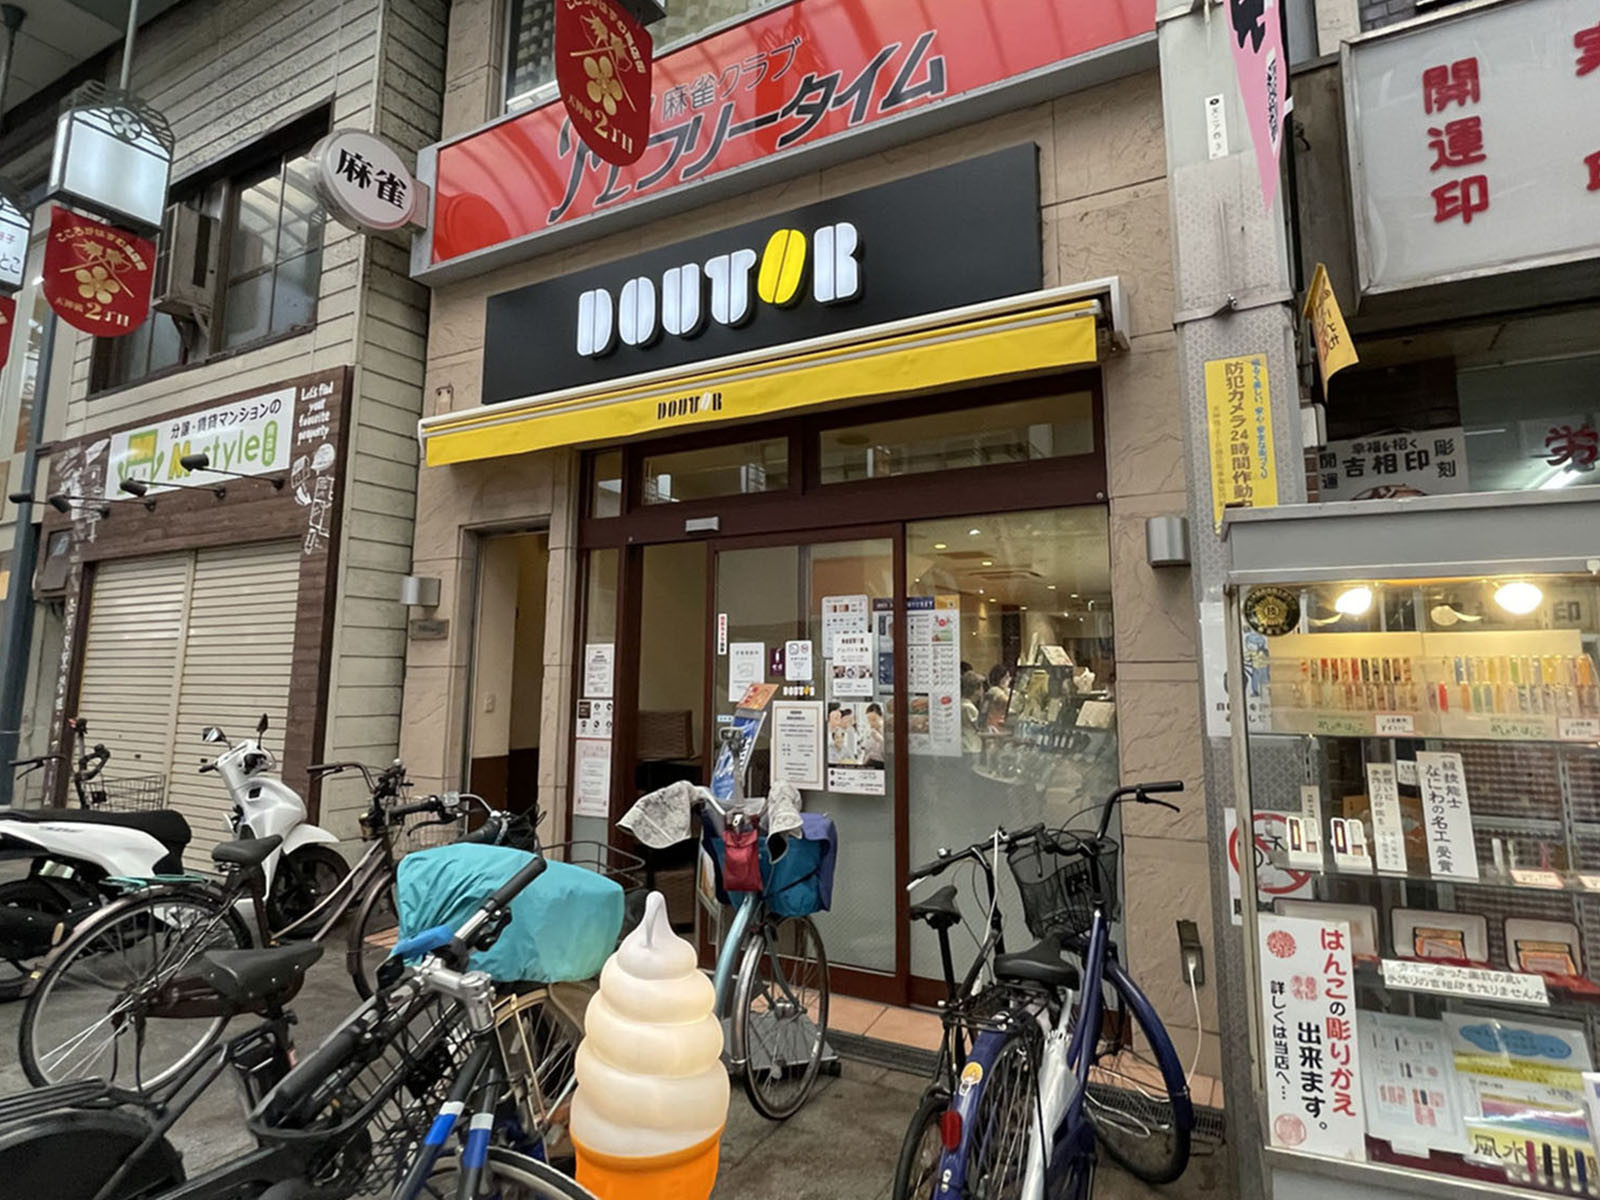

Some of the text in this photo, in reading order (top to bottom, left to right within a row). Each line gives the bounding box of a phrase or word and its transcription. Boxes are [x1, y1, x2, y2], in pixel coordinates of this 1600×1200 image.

[336, 147, 407, 210] 麻雀
[1422, 57, 1490, 225] 開運印
[576, 222, 862, 359] DOUTOR
[657, 391, 723, 421] DOUTOR
[1434, 438, 1456, 478] 彫刻
[1342, 449, 1430, 478] 吉相印
[1425, 764, 1455, 873] なにわの名工受賞
[1298, 1021, 1328, 1130] 出来ます。
[1320, 928, 1357, 1117] はんこの彫りかえ
